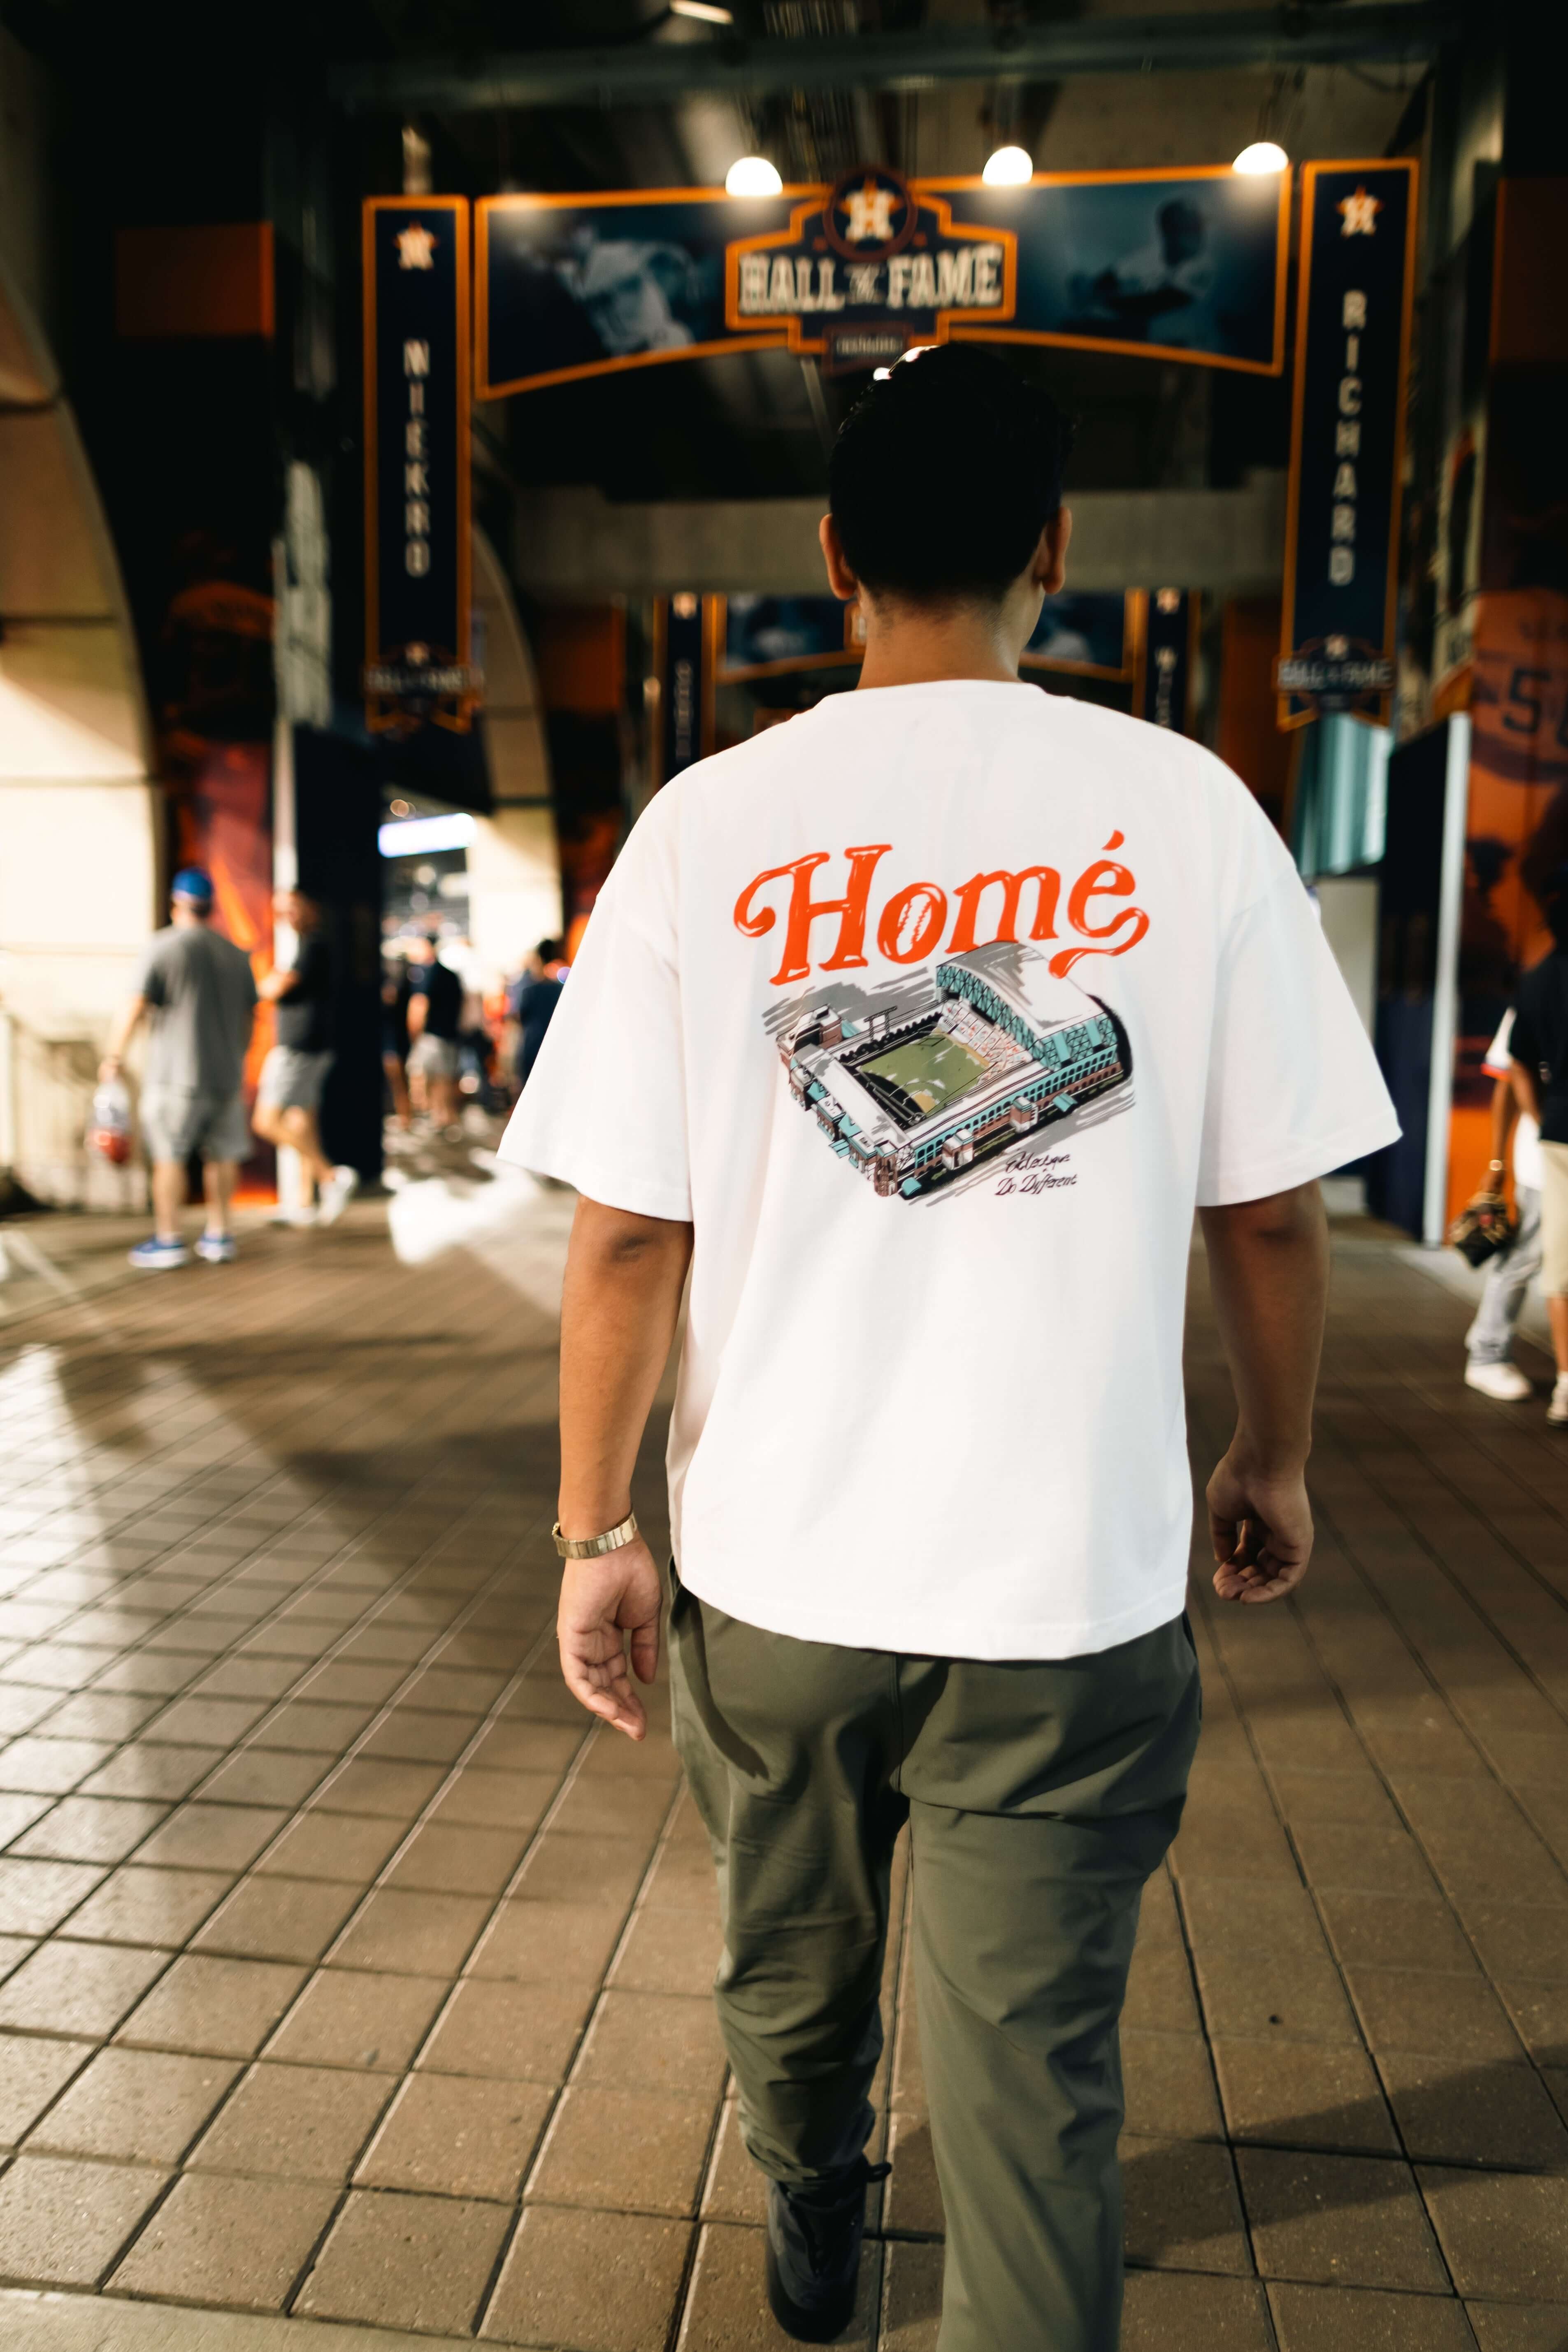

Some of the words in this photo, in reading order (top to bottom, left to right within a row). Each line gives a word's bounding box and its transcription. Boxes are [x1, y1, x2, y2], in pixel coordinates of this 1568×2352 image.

[739, 255, 844, 314] HALL
[887, 242, 1002, 310] FAME
[1329, 289, 1367, 587] RICHARD
[733, 829, 1150, 985] Homé
[994, 1176, 1017, 1195] Do
[1018, 1169, 1078, 1195] Different
